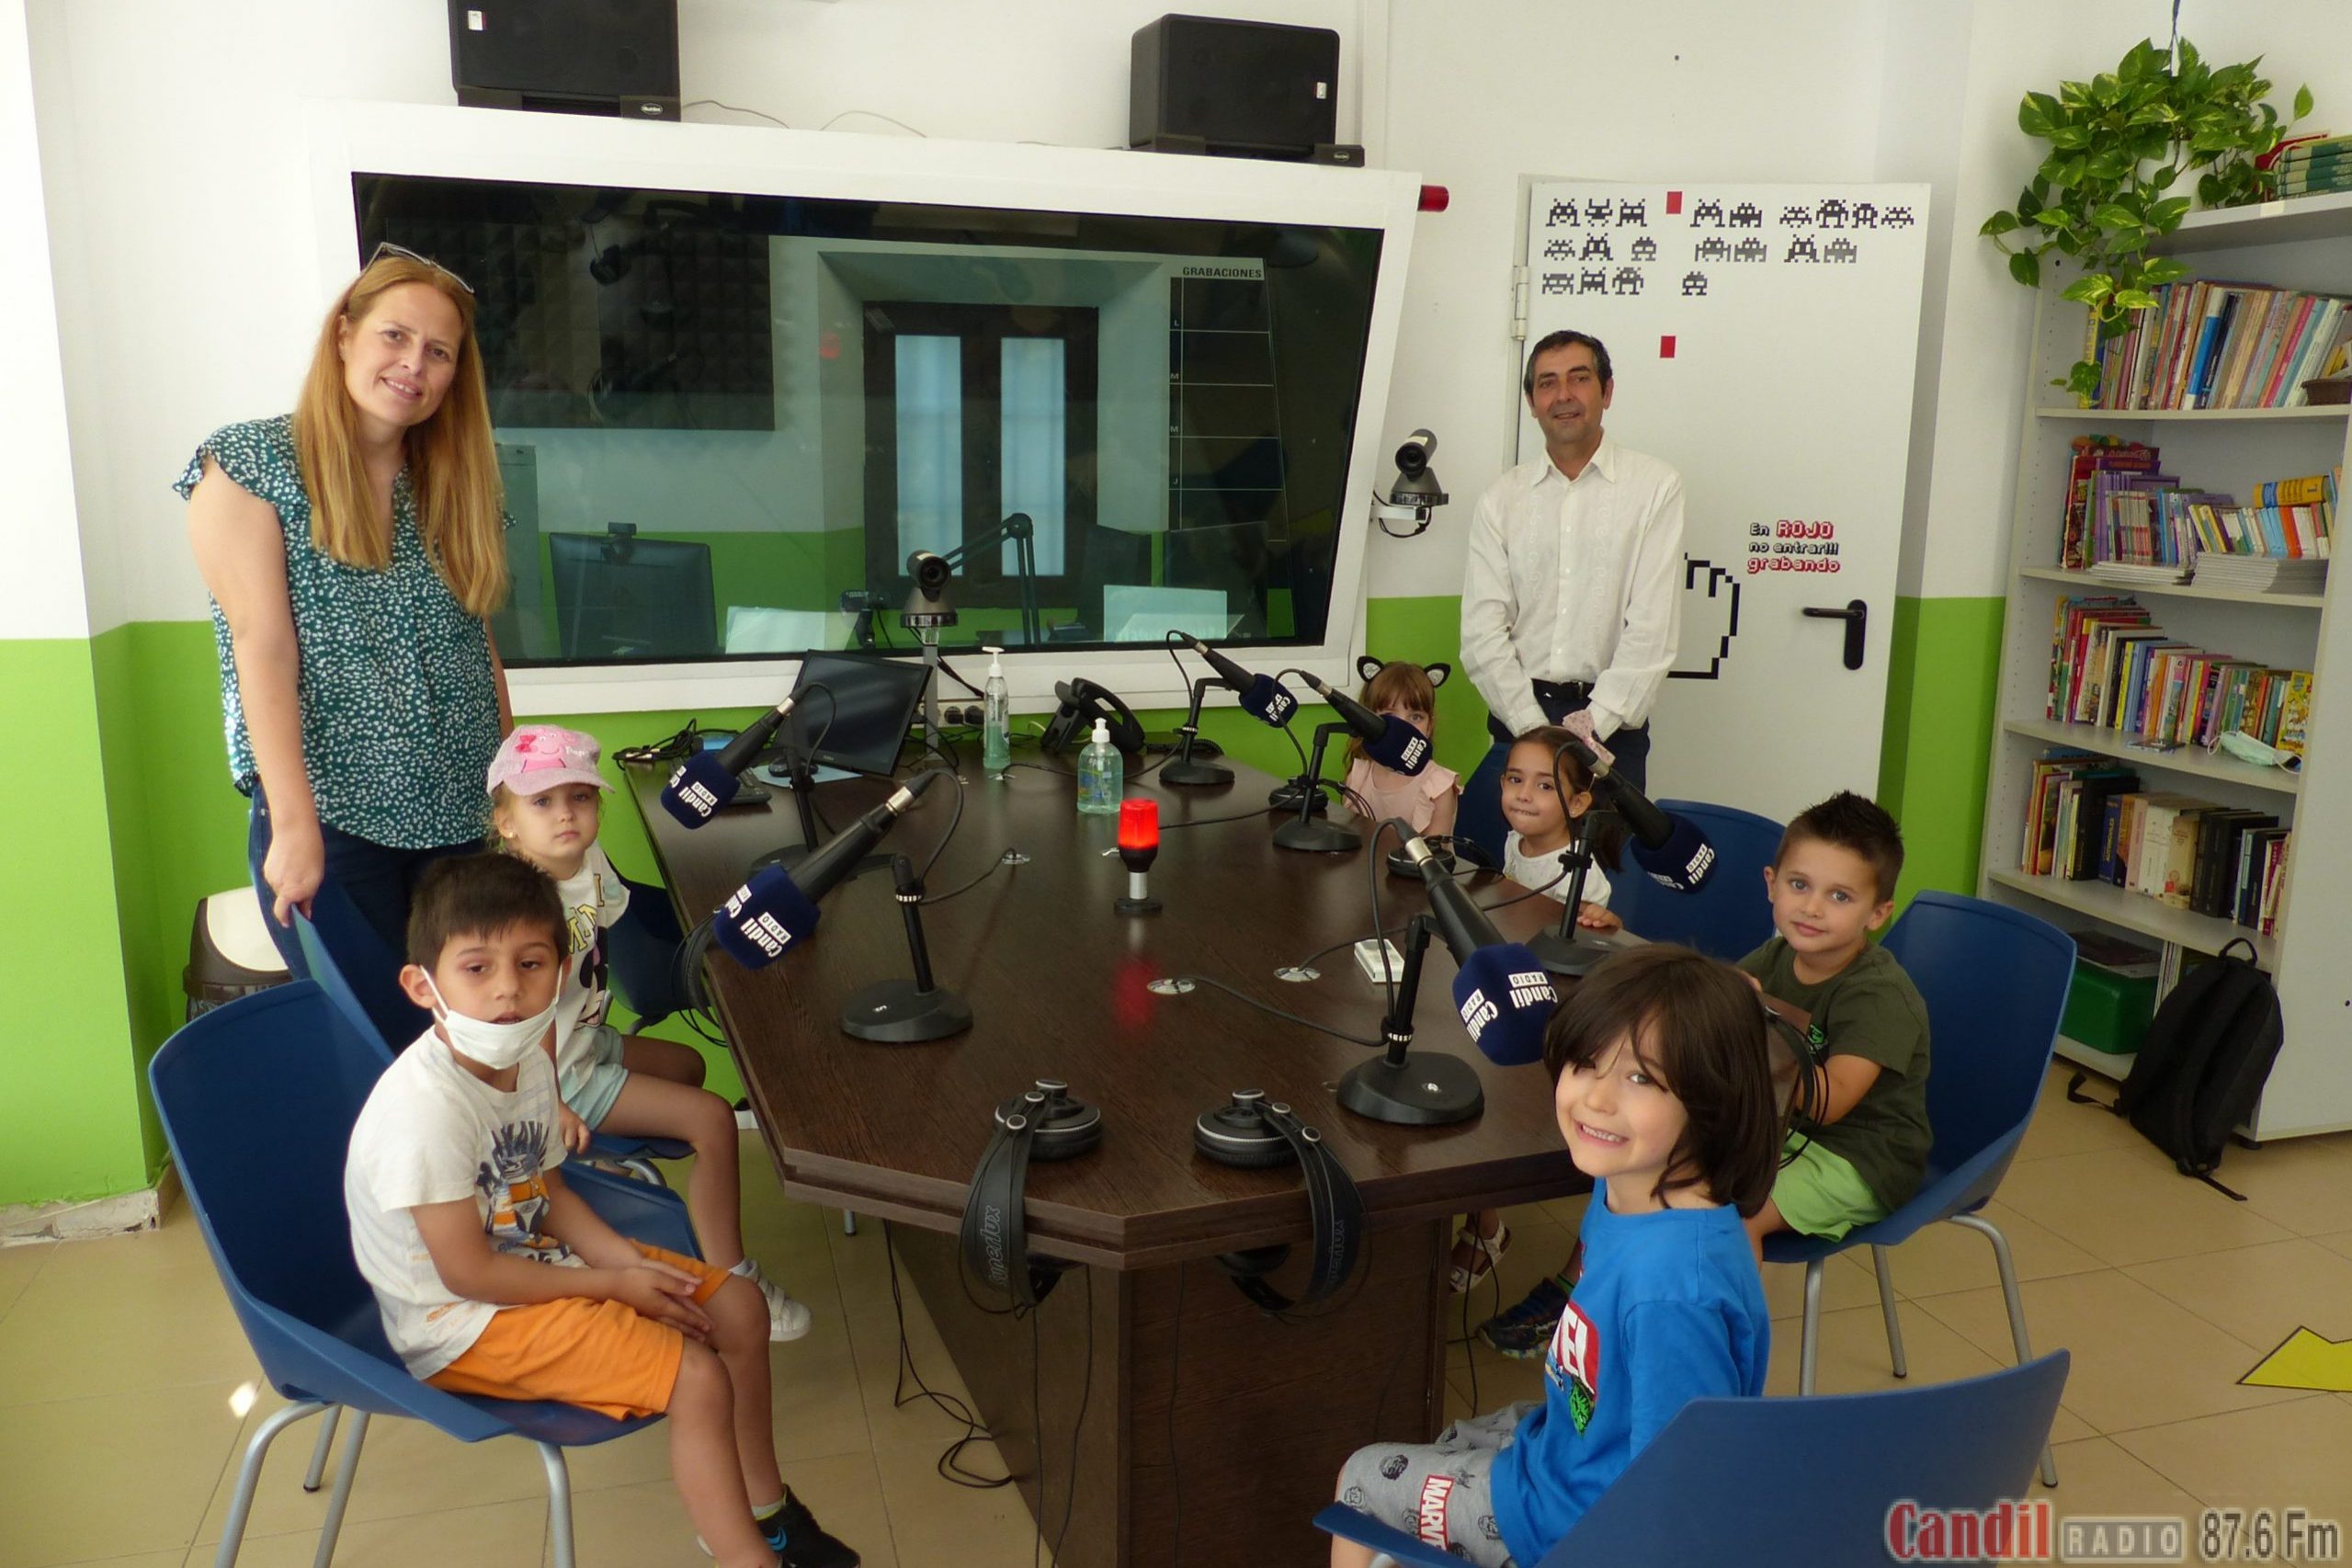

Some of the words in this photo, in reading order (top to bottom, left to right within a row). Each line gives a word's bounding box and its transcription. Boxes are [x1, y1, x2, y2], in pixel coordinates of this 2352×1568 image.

[1182, 267, 1262, 278] GRABACIONES
[1750, 522, 1769, 536] En
[1776, 519, 1834, 540] ROJO
[1749, 541, 1769, 553] no
[1747, 556, 1841, 574] grabando
[678, 786, 712, 817] Candil
[740, 917, 783, 957] Candil
[760, 914, 790, 942] RADIO
[1510, 973, 1546, 986] RADIO
[1509, 986, 1558, 1008] Candil
[1421, 1477, 1452, 1551] MARV
